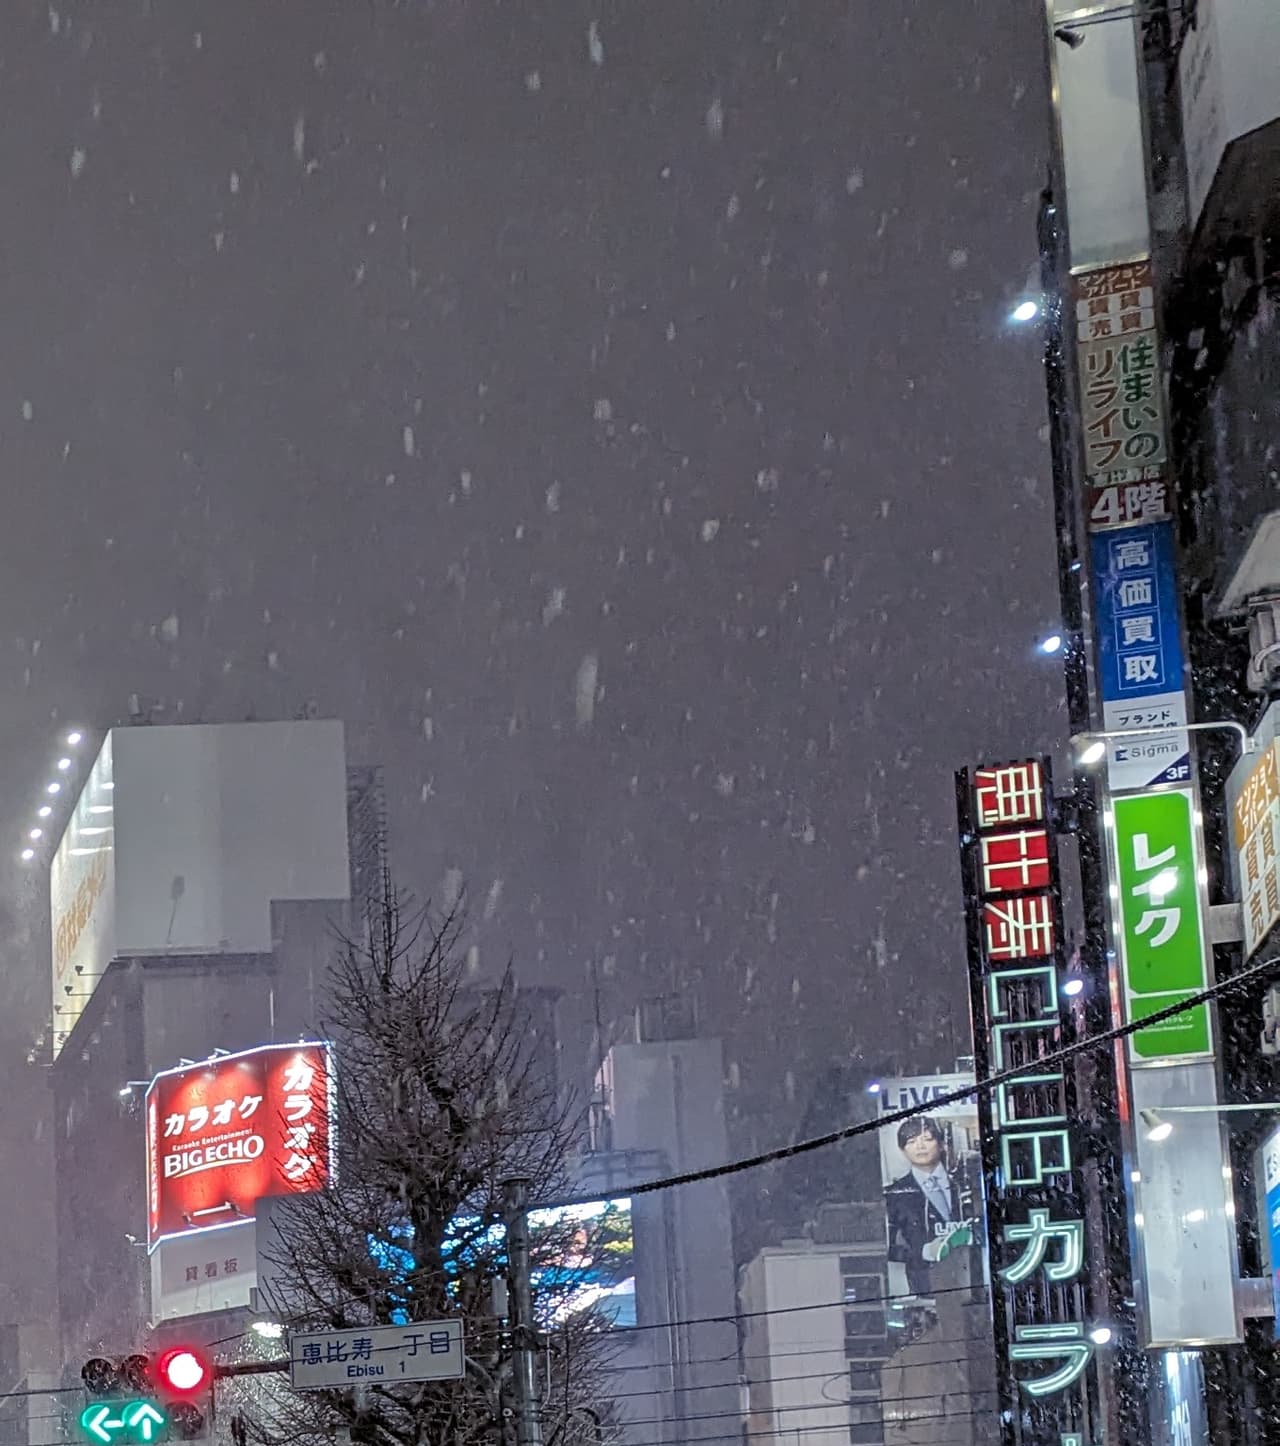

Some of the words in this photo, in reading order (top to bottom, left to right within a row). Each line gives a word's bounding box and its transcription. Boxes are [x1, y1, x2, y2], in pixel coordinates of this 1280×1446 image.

[1079, 265, 1148, 287] マンション
[1088, 279, 1140, 297] アパート
[1087, 349, 1122, 467] リライフ
[1120, 337, 1160, 458] 住まいの
[1091, 482, 1166, 523] 4階
[1116, 540, 1160, 684] 高価買取
[1119, 710, 1171, 726] ブランド
[1131, 743, 1178, 758] Sigma
[1166, 766, 1189, 780] 3F
[1237, 751, 1274, 820] マンション
[975, 762, 1053, 958] 恵比寿
[1132, 833, 1180, 948] レイク
[164, 1096, 263, 1137] カラオケ
[283, 1062, 316, 1179] カラオケ
[164, 1149, 202, 1178] BIG
[206, 1135, 264, 1162] ECHO
[302, 1331, 450, 1365] 恵比寿一丁目
[347, 1366, 384, 1377] Ebisu
[399, 1361, 406, 1373] 1
